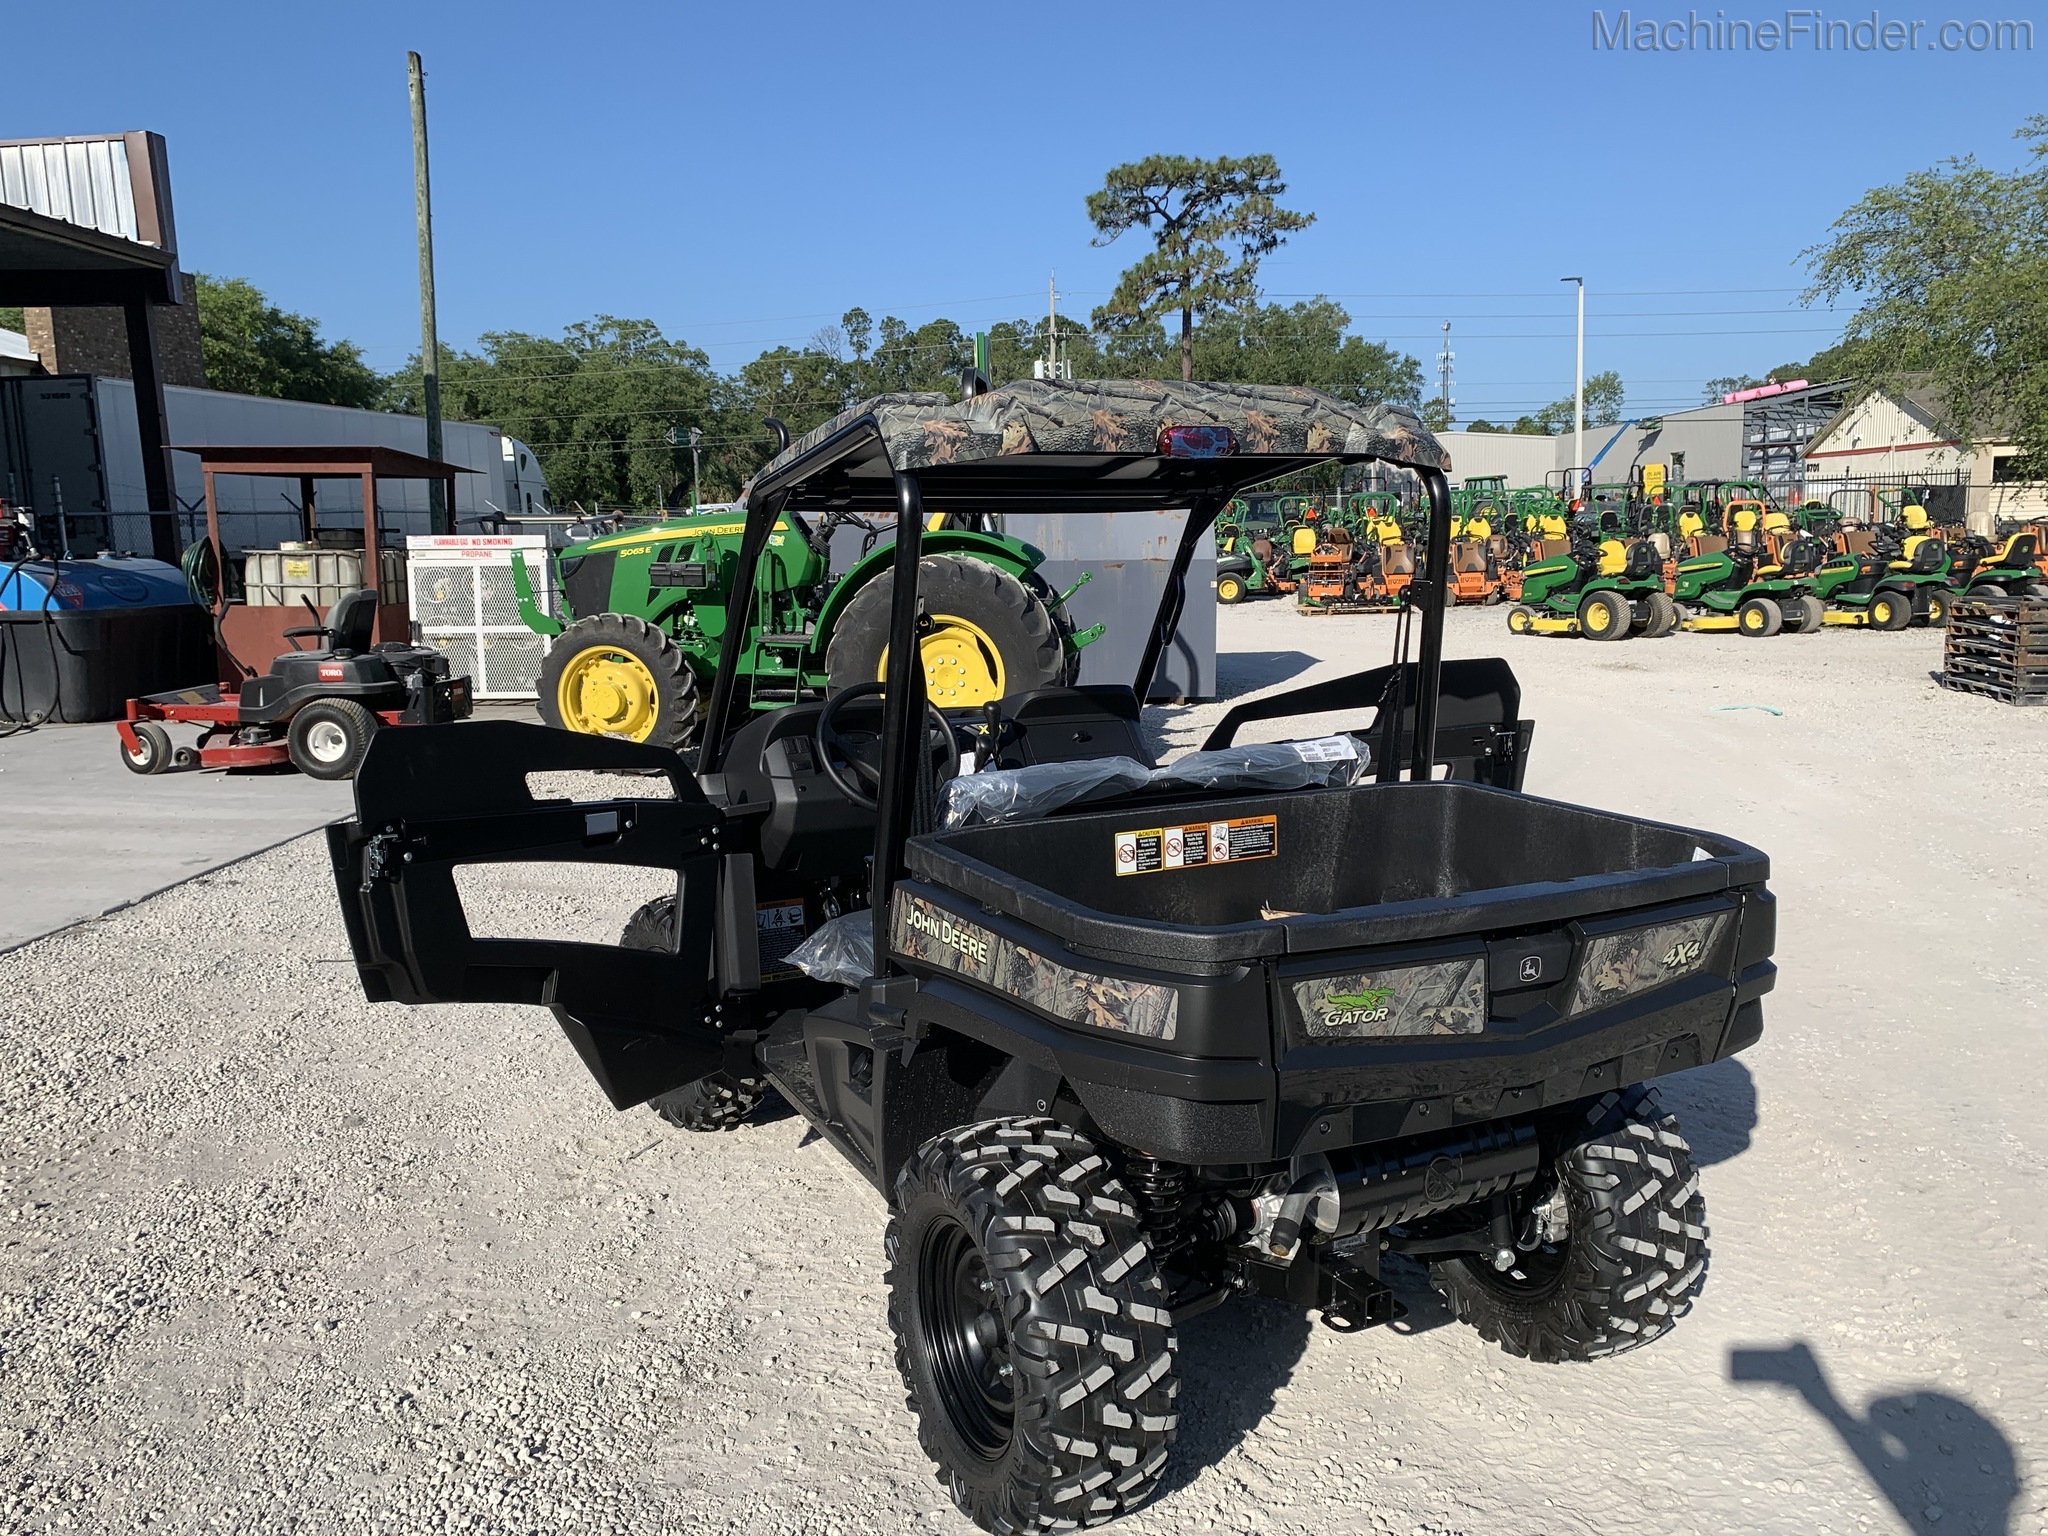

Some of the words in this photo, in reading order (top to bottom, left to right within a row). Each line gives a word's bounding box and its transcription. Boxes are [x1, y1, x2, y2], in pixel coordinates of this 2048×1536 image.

[460, 538, 468, 546] GAS
[472, 538, 481, 546] NO
[461, 550, 493, 558] PROPANE
[321, 669, 343, 677] TORO
[979, 724, 1008, 734] XV
[906, 904, 940, 939] JOHN
[941, 919, 988, 964] DEERE
[1662, 941, 1701, 967] 4X4
[1324, 1007, 1389, 1027] GATOR
